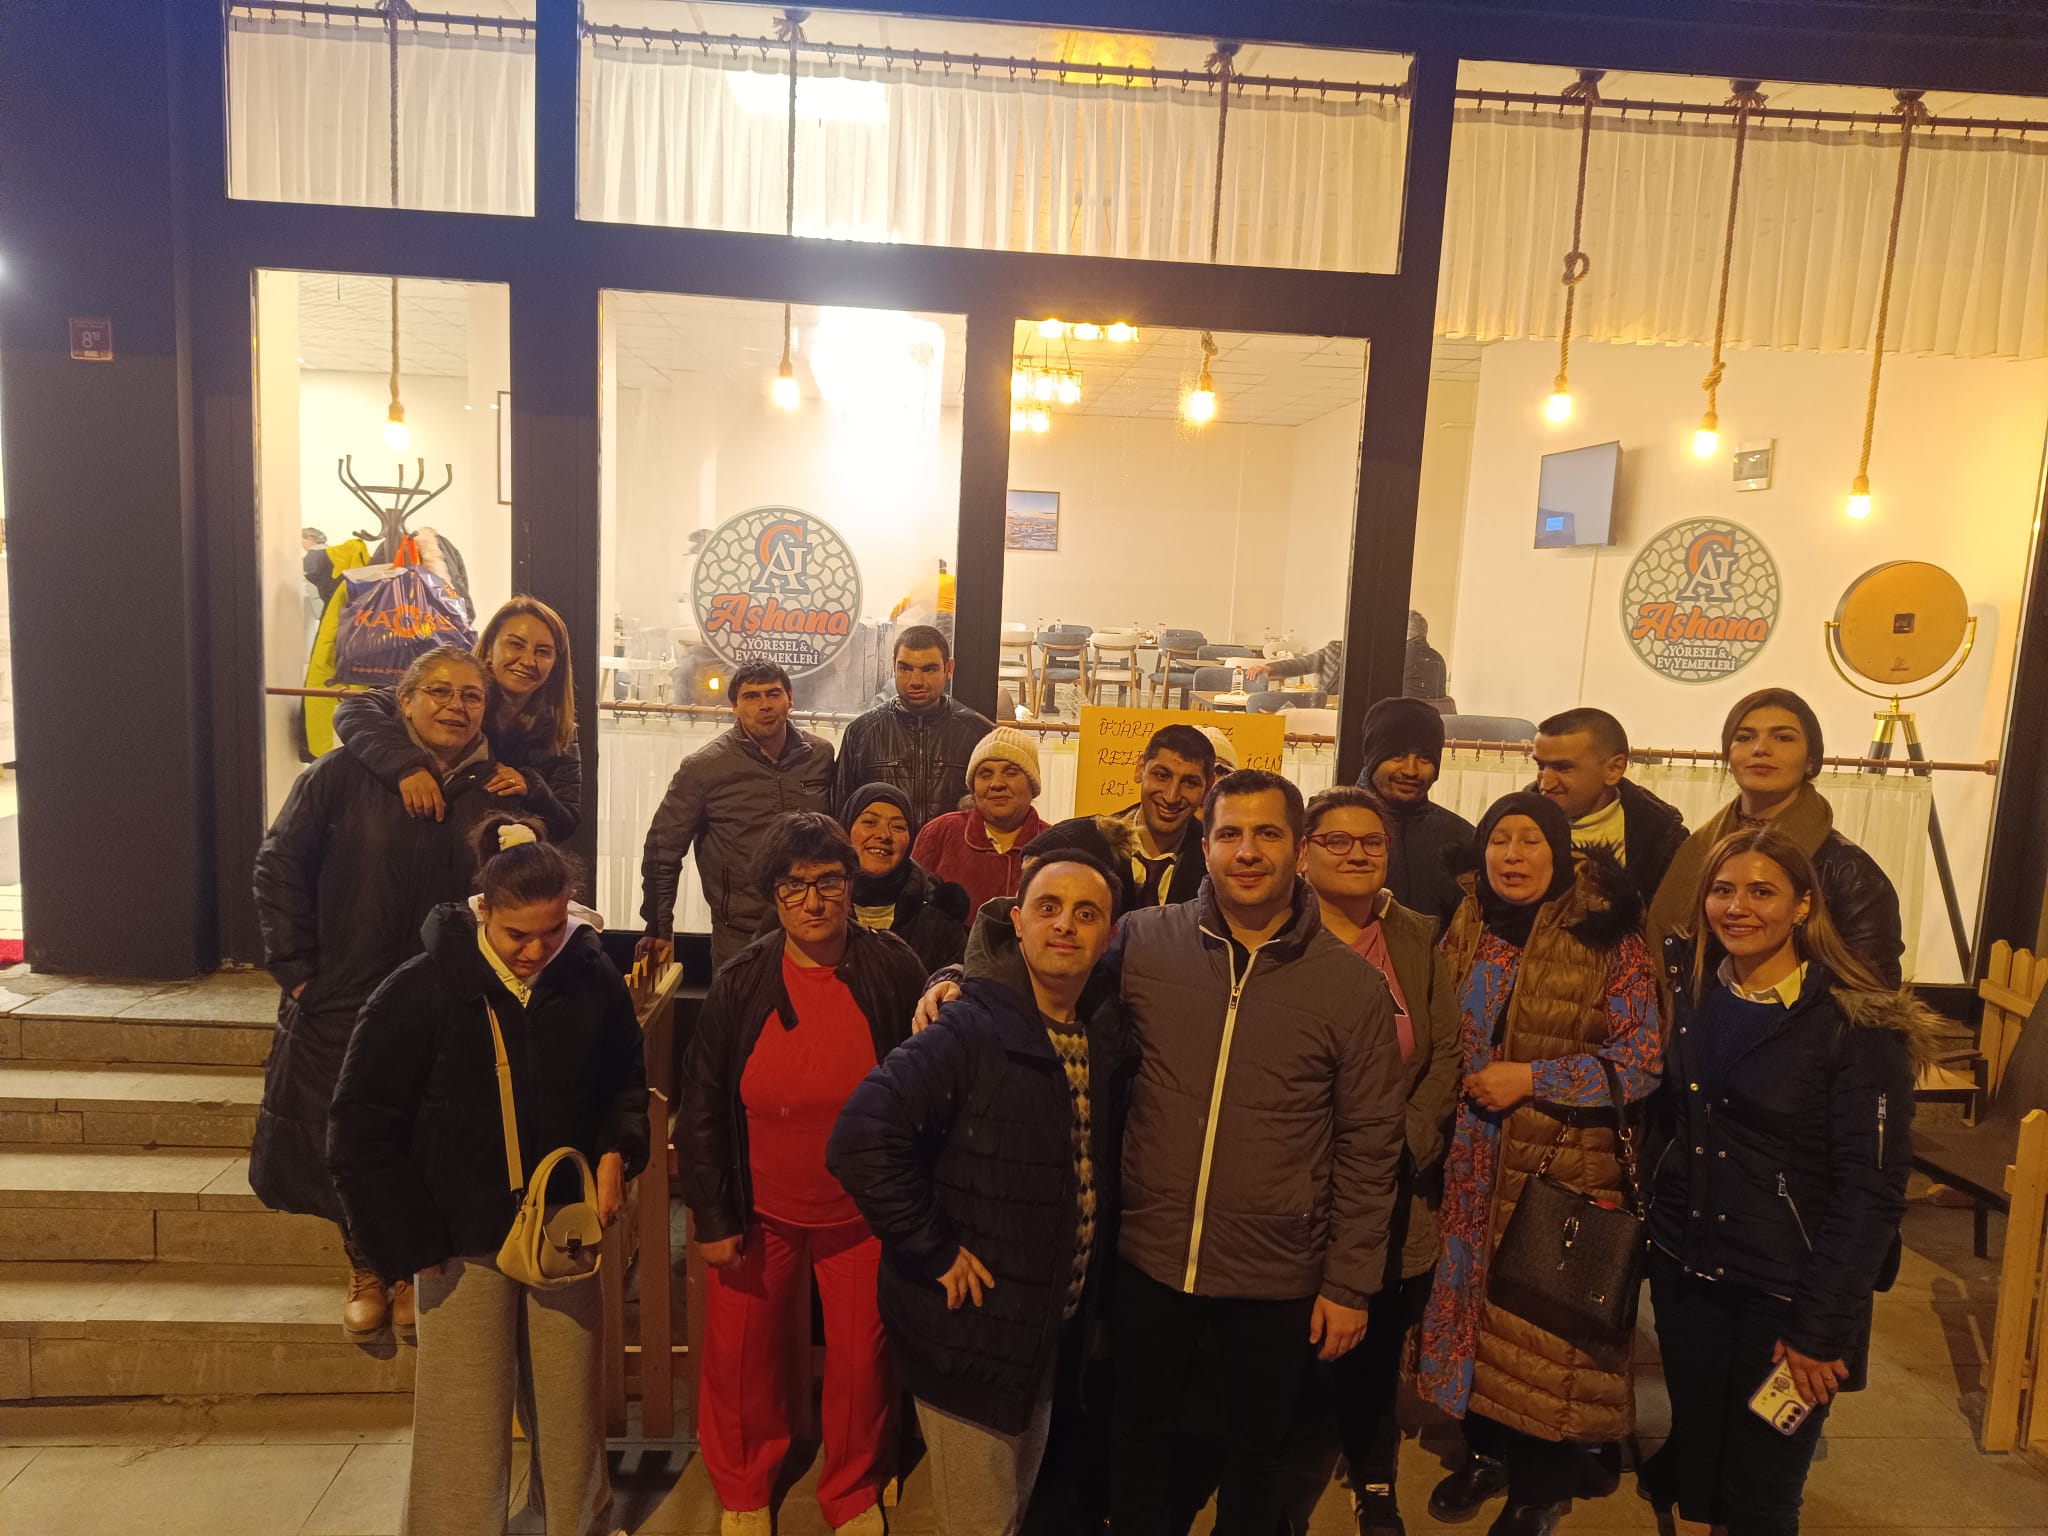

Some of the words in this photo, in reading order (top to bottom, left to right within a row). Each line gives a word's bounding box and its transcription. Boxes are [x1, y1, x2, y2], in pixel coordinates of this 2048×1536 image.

[706, 593, 850, 635] Aşhana
[1632, 602, 1769, 643] Aşhana
[746, 637, 798, 651] YÖRESEL
[799, 641, 808, 652] &
[1668, 644, 1718, 658] YÖRESEL
[1718, 648, 1728, 659] &
[735, 650, 750, 662] EV
[1655, 657, 1672, 668] EV
[1672, 657, 1736, 671] YEMEKLERİ
